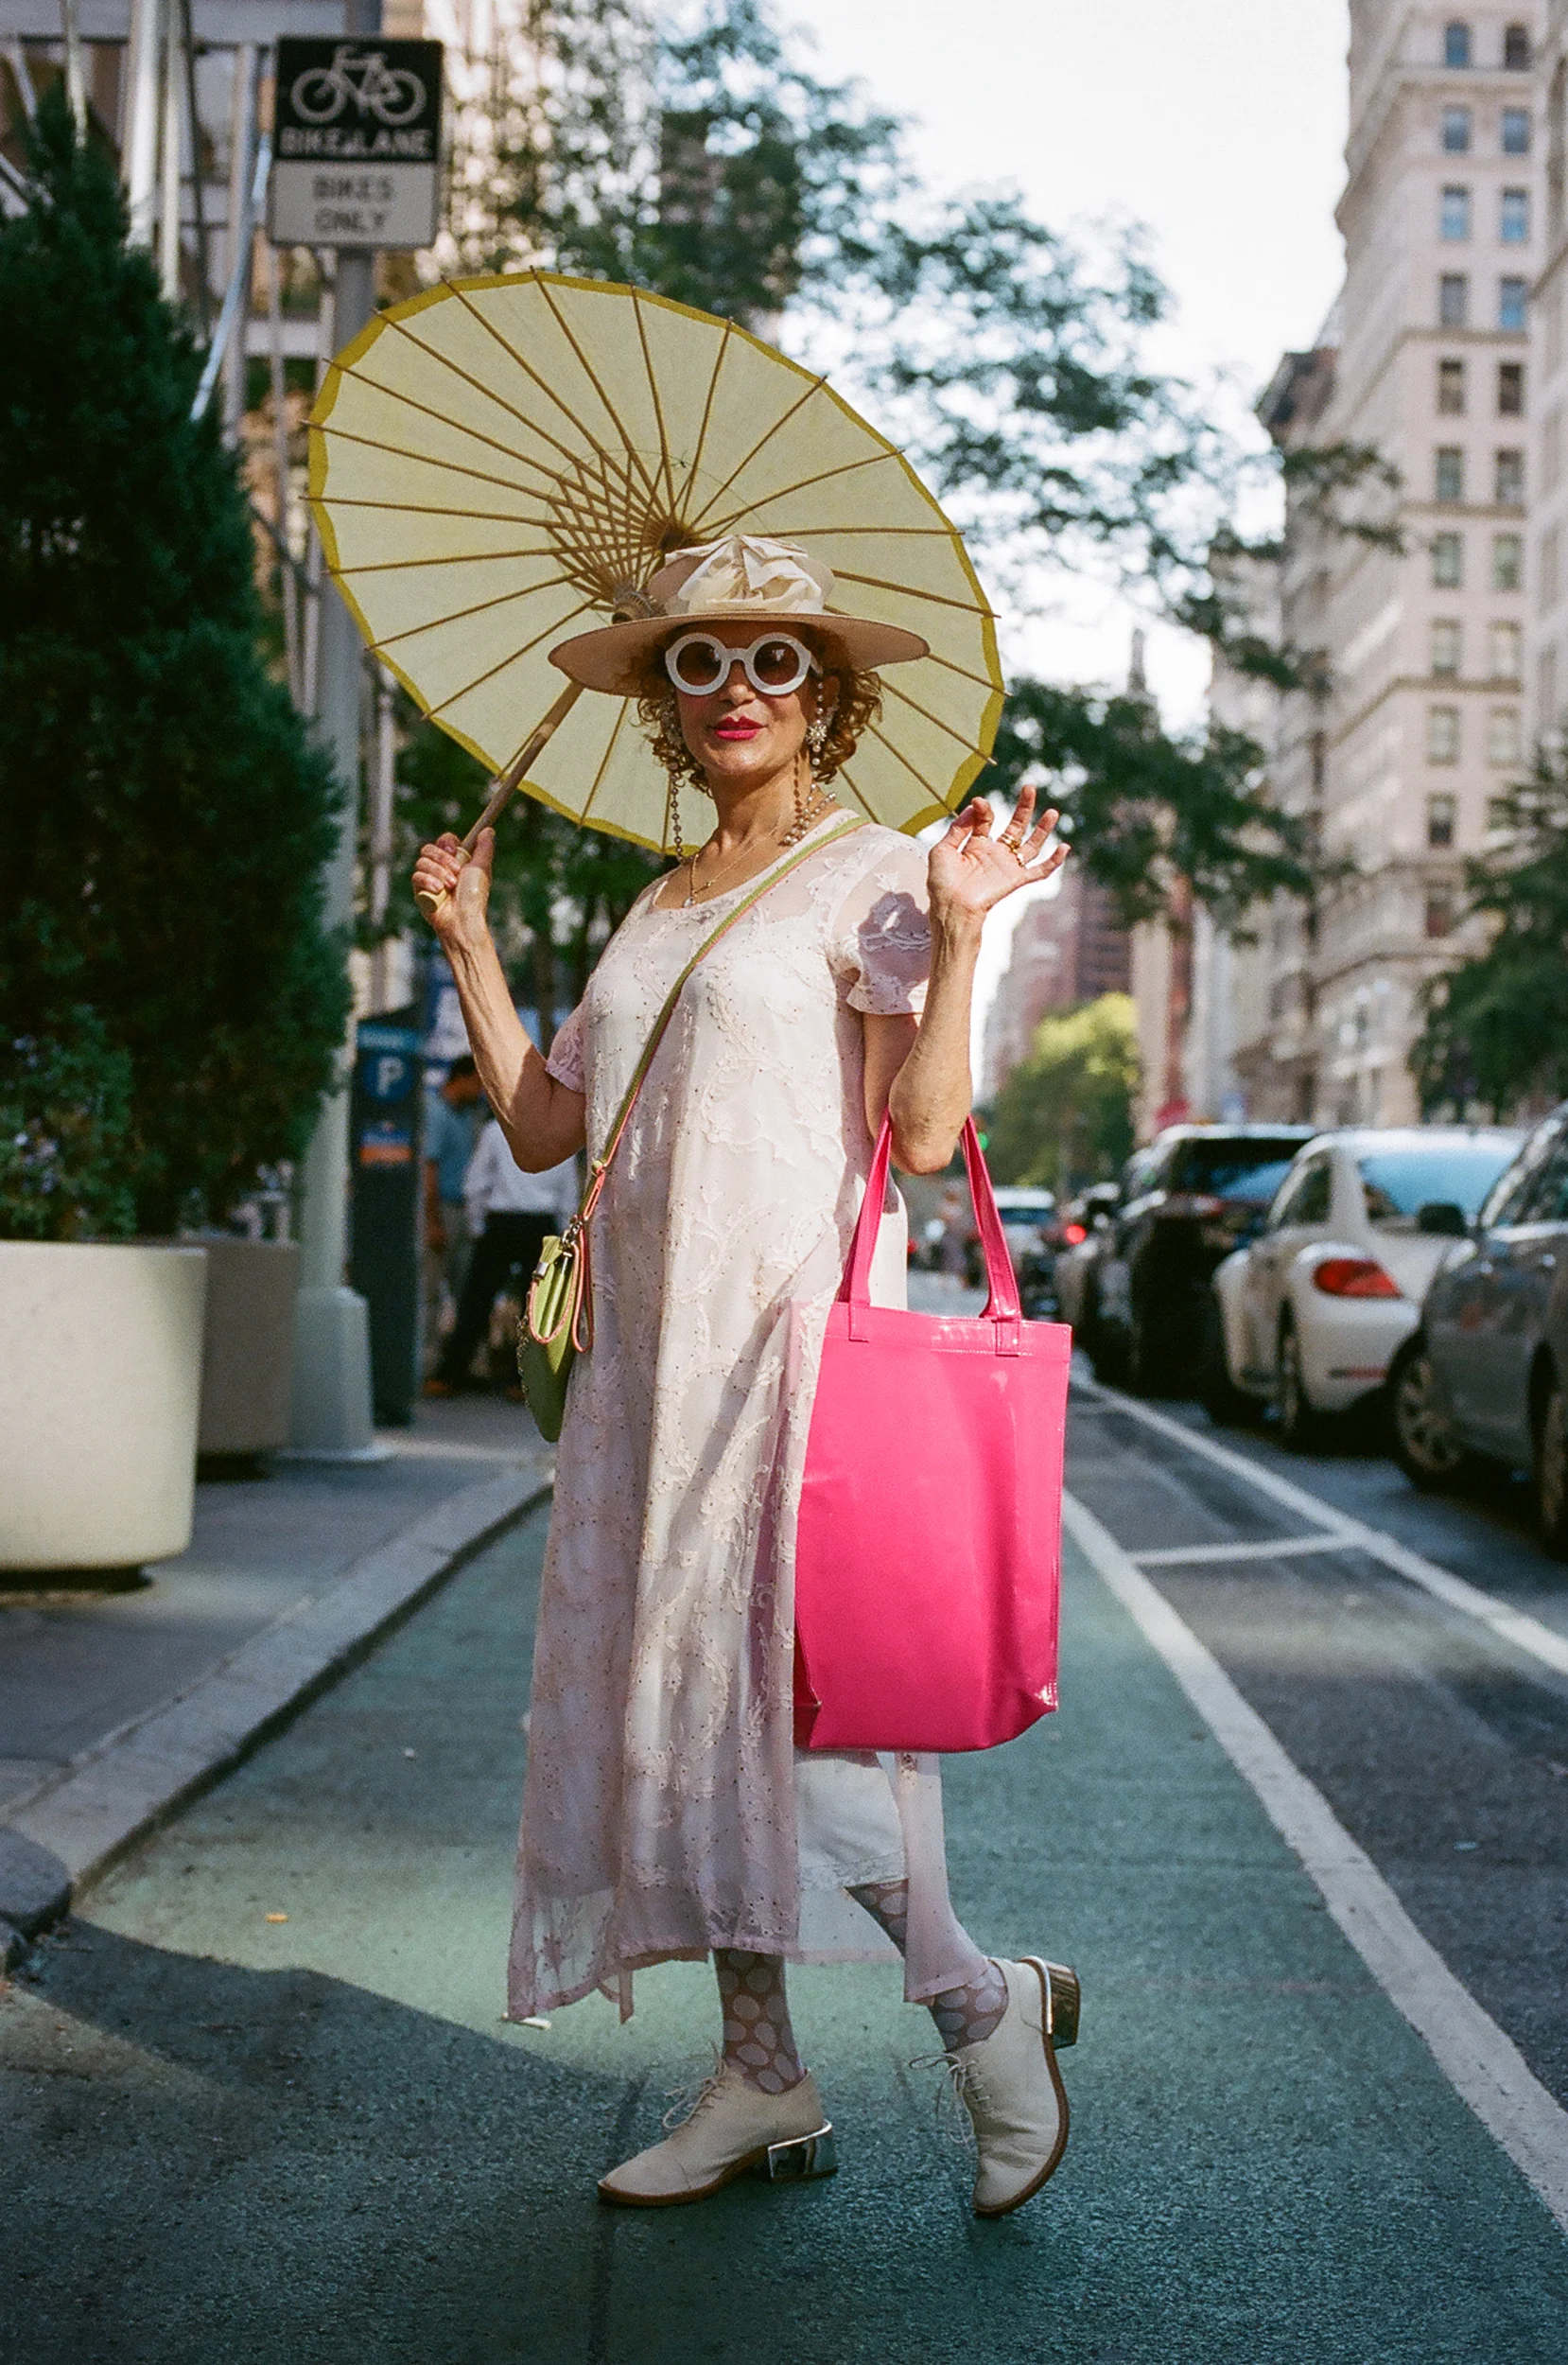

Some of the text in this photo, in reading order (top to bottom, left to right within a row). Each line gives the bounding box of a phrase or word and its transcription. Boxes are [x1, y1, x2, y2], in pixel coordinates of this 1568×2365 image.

[280, 126, 432, 156] BIKE LANE
[312, 174, 393, 201] BIKES
[313, 207, 388, 233] ONLY
[375, 1055, 405, 1096] P
